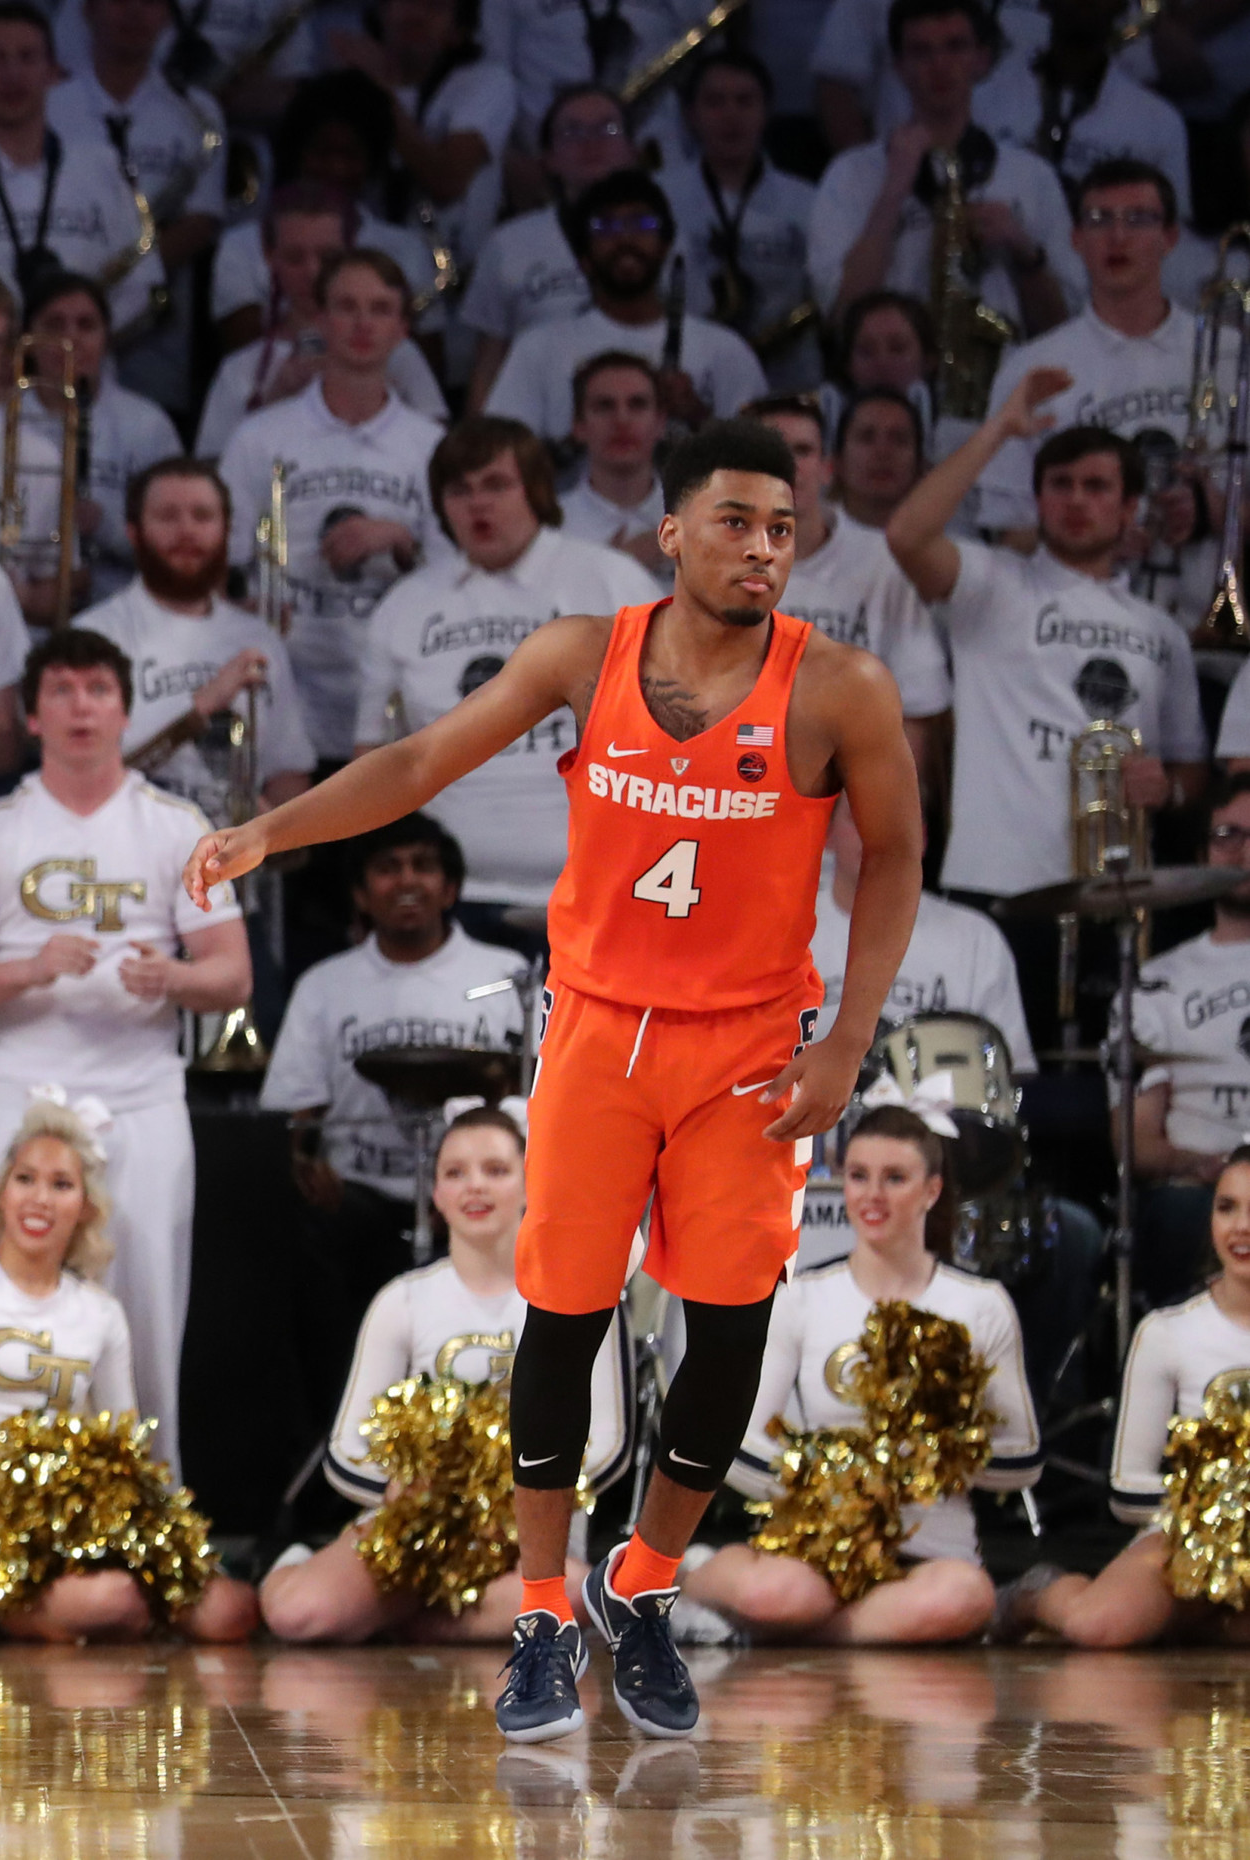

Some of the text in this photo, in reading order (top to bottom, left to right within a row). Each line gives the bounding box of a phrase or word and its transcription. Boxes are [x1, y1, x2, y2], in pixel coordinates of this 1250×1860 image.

[1036, 602, 1172, 664] GEORGIA
[588, 763, 781, 820] SYRACUSE
[20, 858, 146, 933] GT
[633, 838, 702, 919] 4
[342, 1014, 494, 1062] GEORGIA
